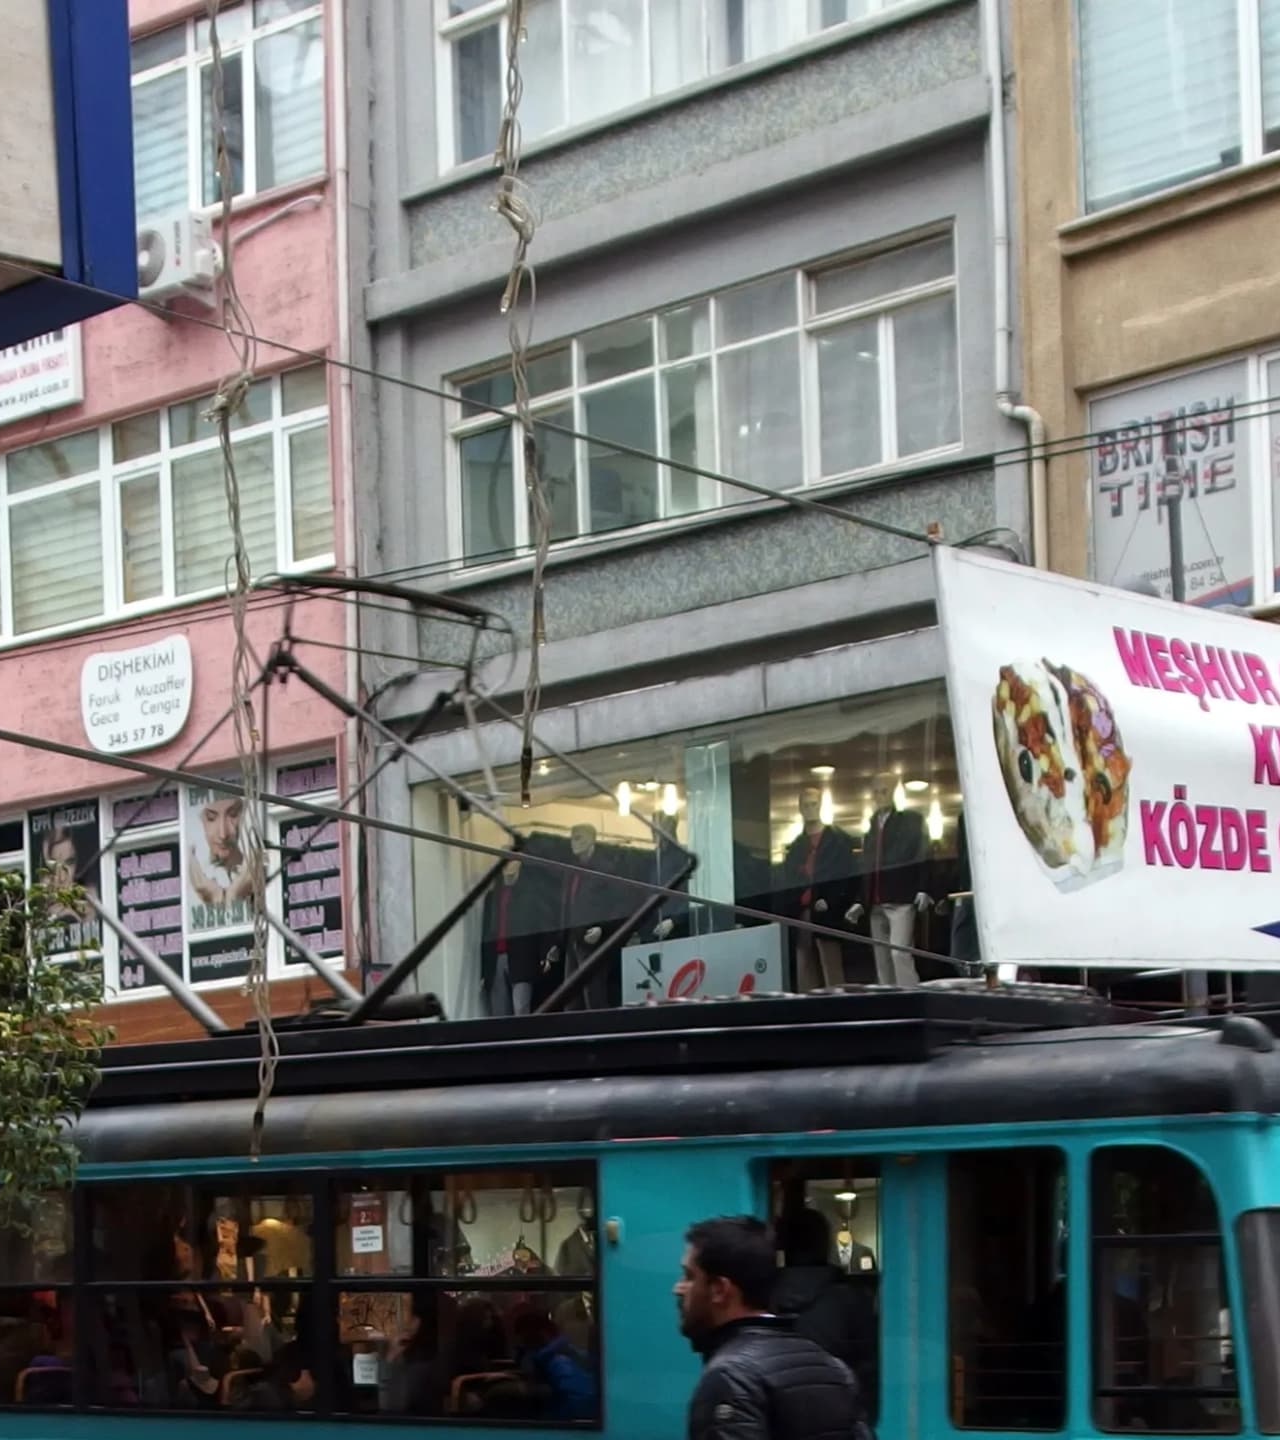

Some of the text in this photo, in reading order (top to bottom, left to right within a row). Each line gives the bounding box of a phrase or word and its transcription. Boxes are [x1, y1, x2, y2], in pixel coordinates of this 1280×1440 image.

[1098, 396, 1236, 477] BRITISH
[134, 675, 186, 697] Muzaffer
[90, 698, 180, 727] Gece Cengiz
[108, 723, 165, 747] 345 57 78
[1140, 784, 1271, 872] KÖZDE
